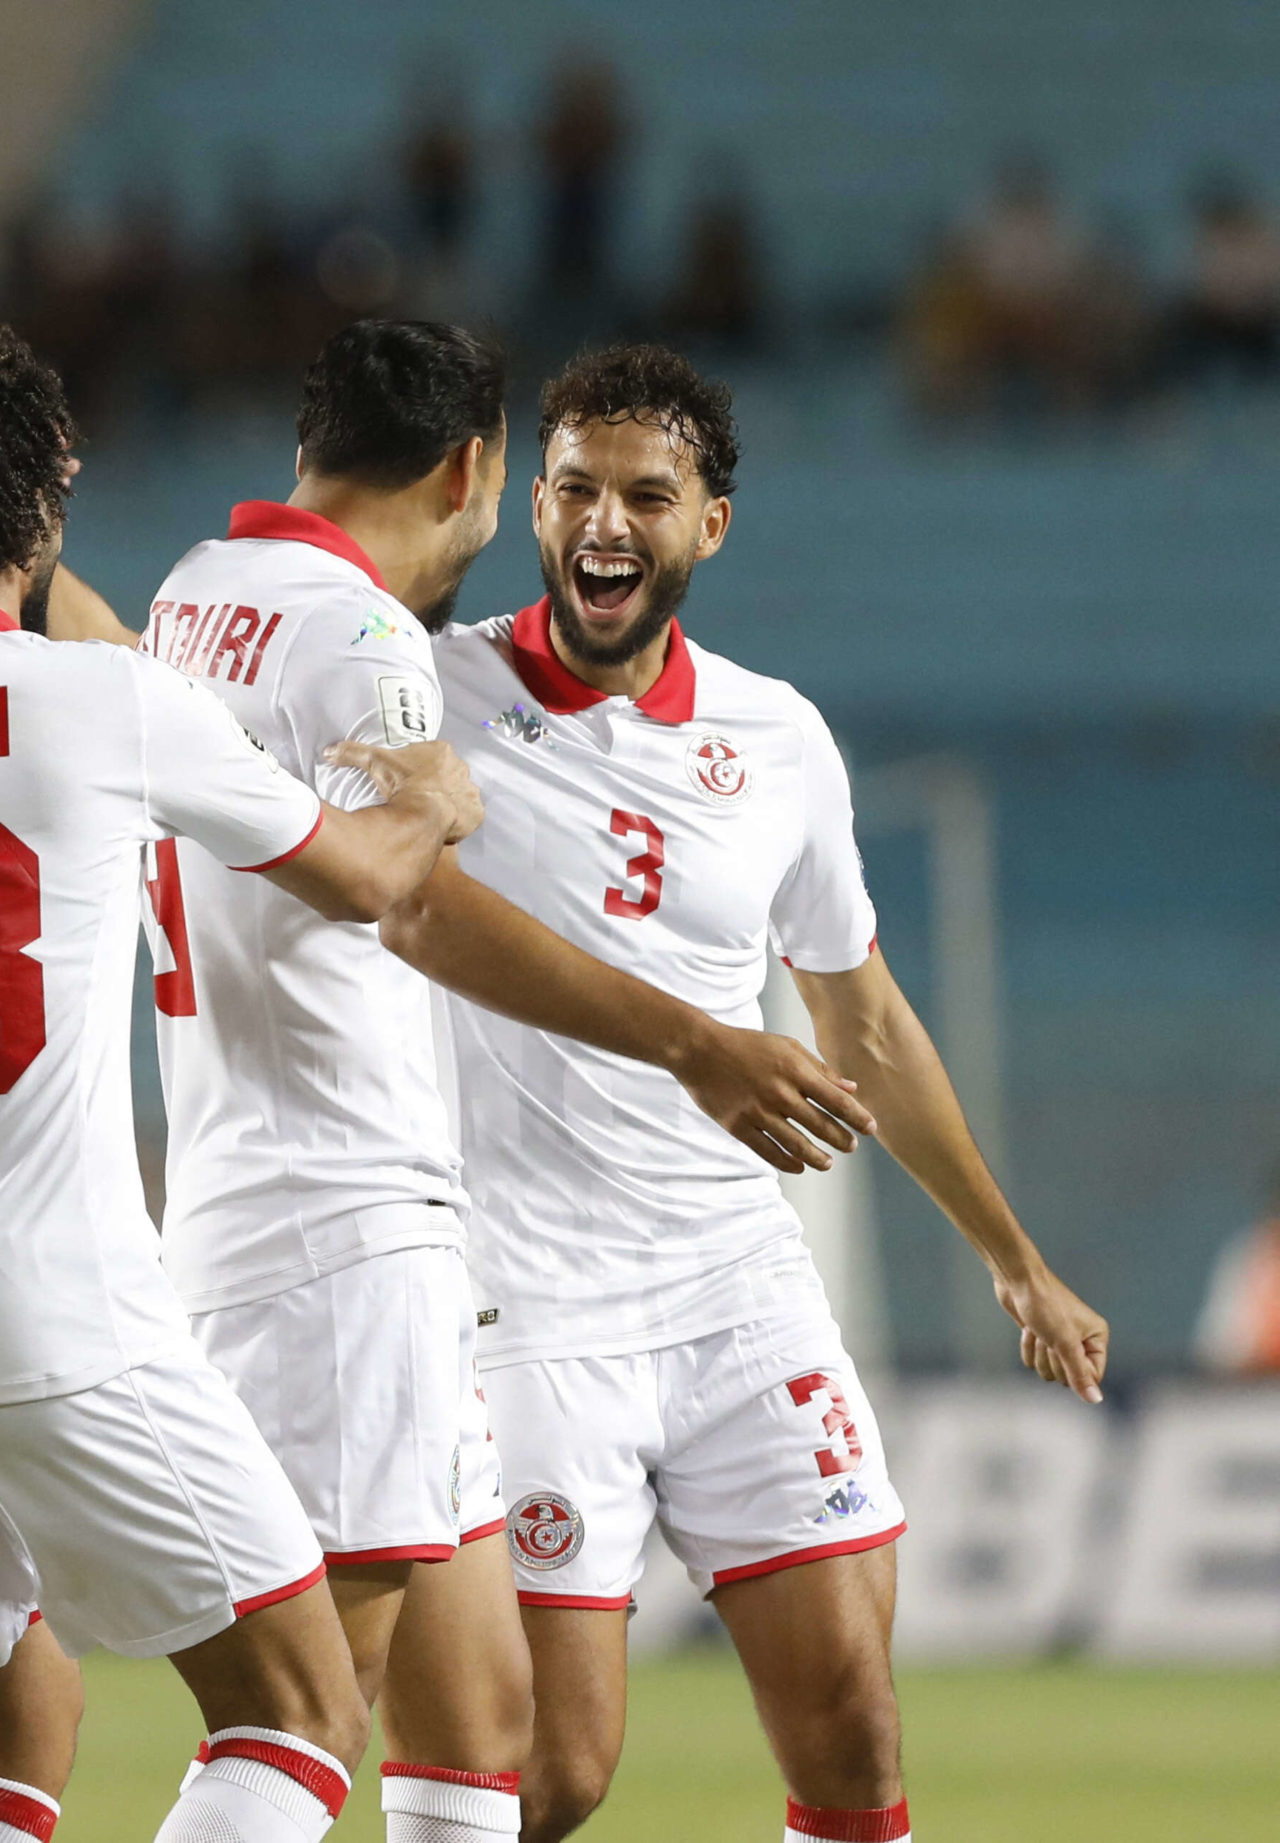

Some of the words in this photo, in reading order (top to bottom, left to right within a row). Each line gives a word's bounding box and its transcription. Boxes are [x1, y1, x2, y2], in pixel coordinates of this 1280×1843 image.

[135, 600, 284, 686] TOURI
[604, 808, 664, 921] 3
[786, 1372, 863, 1478] 3
